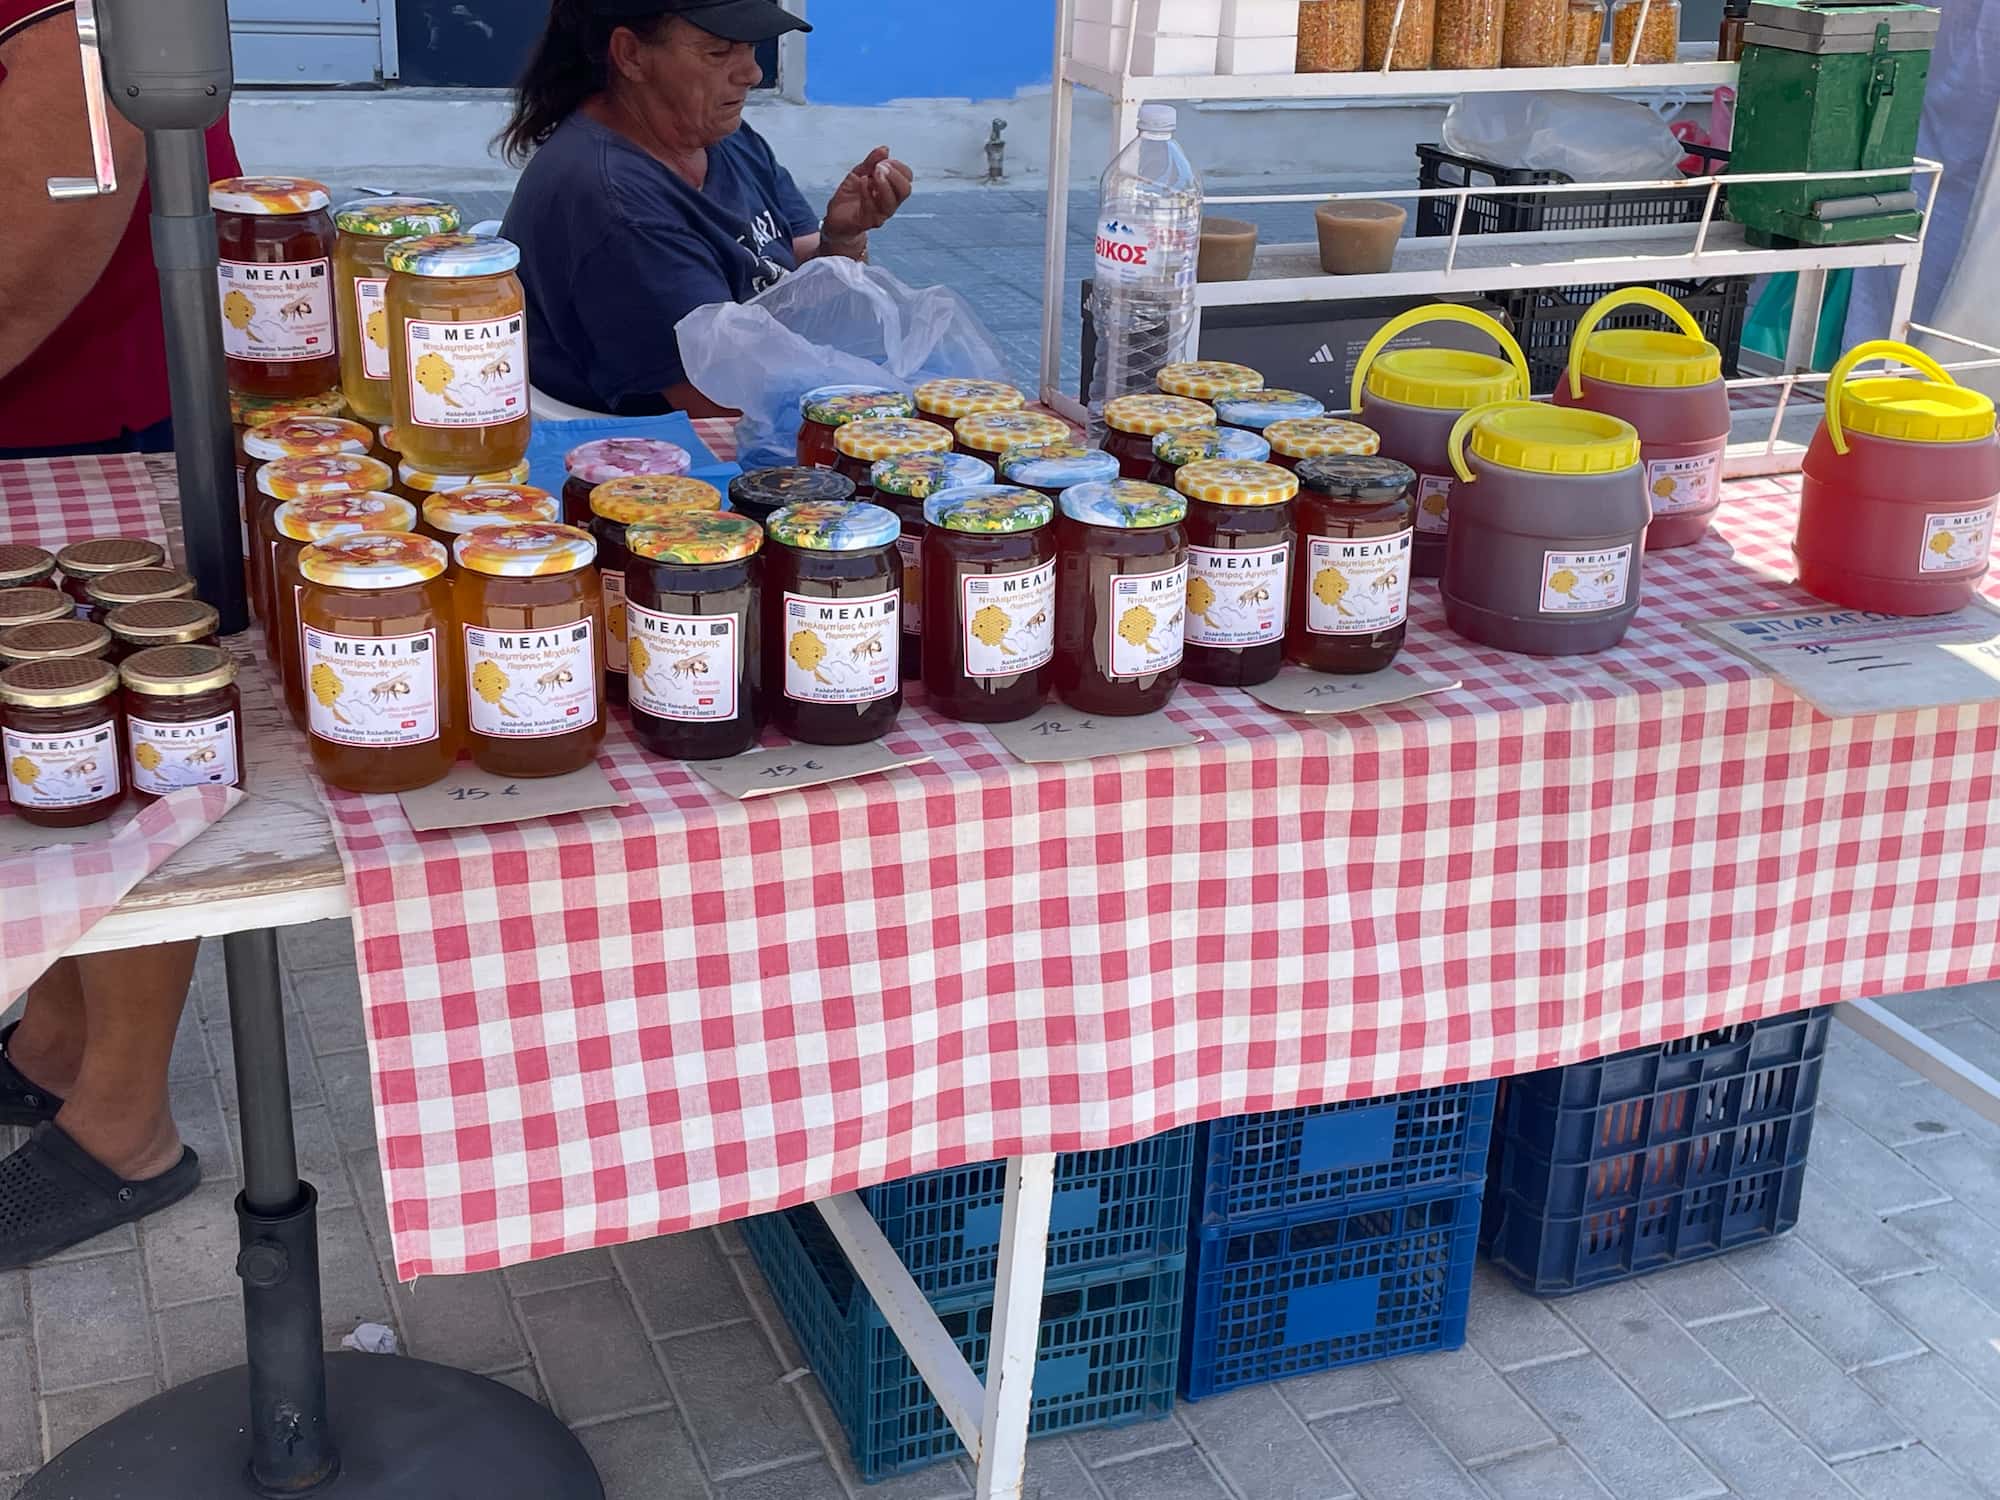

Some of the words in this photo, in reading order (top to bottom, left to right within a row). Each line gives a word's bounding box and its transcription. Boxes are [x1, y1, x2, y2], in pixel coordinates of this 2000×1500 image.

[1095, 235, 1148, 265] ΒΙΚΟΣ
[246, 269, 299, 280] ΜΕΛΙ
[444, 325, 500, 340] ΜΕΛΙ
[1674, 461, 1704, 470] ΜΕΛΙ
[1342, 543, 1391, 557] ΜΕΛΙ
[1210, 557, 1261, 568] ΜΕΛΙ
[1576, 555, 1611, 563] ΜΕΛΙ
[1004, 570, 1047, 592] ΜΕΛΙ
[820, 606, 873, 620] ΜΕΛΙ
[645, 618, 696, 636] ΜΕΛΙ
[1761, 609, 1904, 632] ΠΑΡΑΓΩ
[334, 641, 396, 656] ΜΕΛΙ
[499, 634, 559, 649] ΜΕΛΙ
[155, 728, 205, 738] ΜΕΛΙ
[32, 739, 84, 750] ΜΕΛΙ
[760, 764, 799, 777] 15
[448, 786, 490, 800] 15
